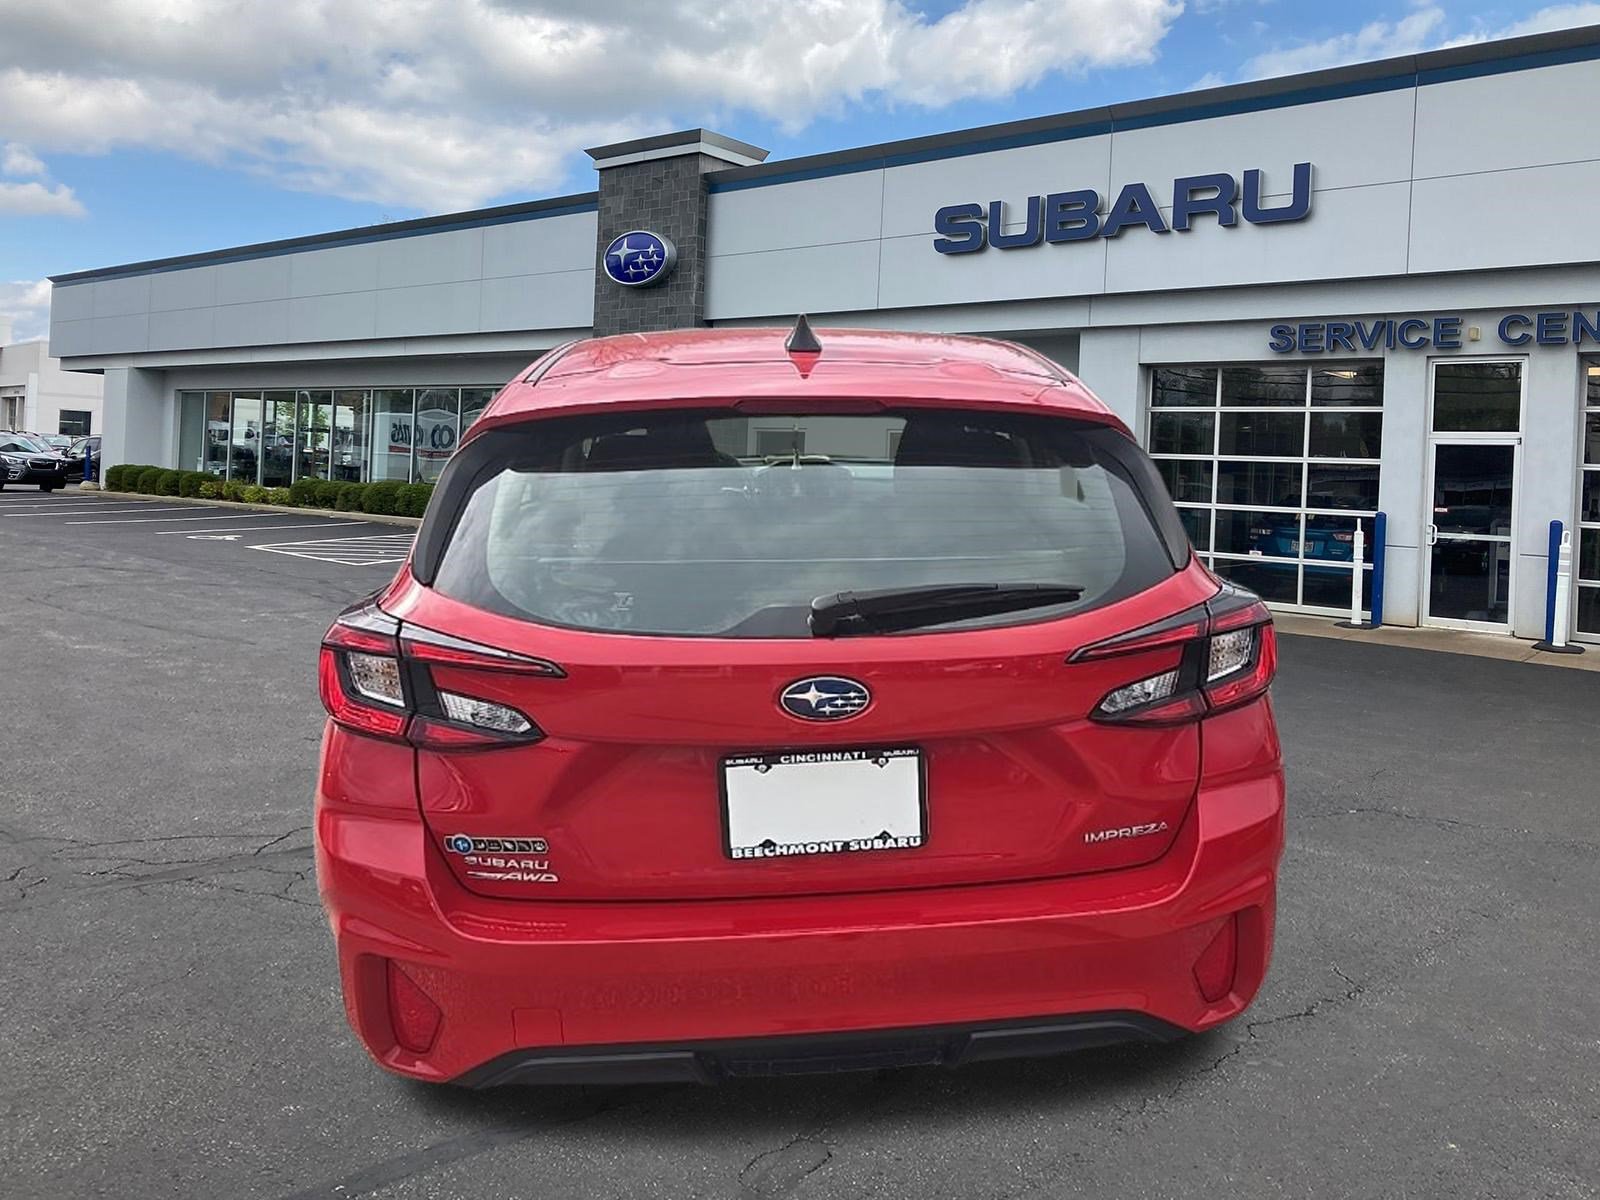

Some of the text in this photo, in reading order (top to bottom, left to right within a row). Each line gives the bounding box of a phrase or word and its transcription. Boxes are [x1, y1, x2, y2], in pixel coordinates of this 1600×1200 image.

[933, 161, 1313, 255] SUBARU
[1269, 310, 1600, 353] SERVICE CEN
[780, 751, 866, 764] CINCINNATI
[1084, 821, 1168, 843] IMPREZA
[731, 836, 921, 859] BEECHMONT SUBARU
[464, 856, 549, 870] SUBARU
[501, 871, 559, 882] AWD
